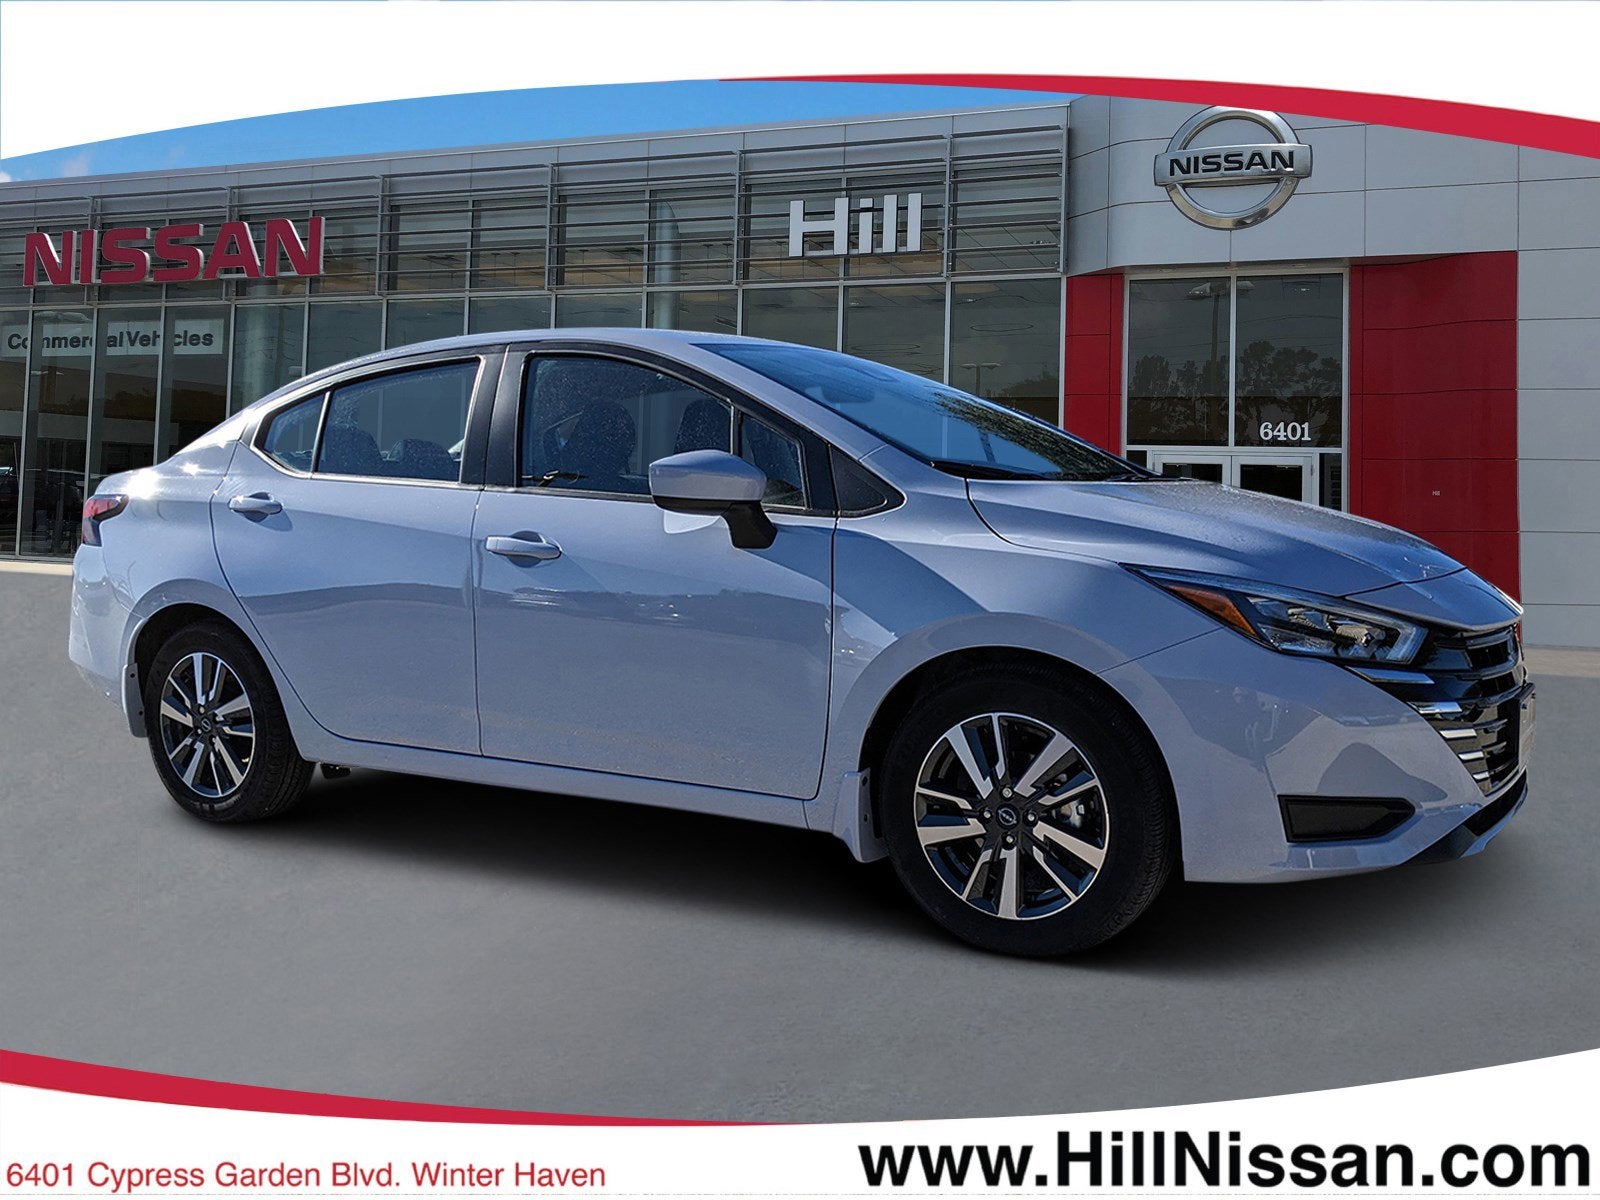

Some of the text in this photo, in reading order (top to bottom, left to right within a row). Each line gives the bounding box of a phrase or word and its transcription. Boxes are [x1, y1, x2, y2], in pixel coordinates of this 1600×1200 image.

[1169, 150, 1295, 177] NISSAN
[788, 192, 923, 257] Hill
[23, 216, 325, 287] NISSAN
[126, 330, 214, 348] Vehcles
[1259, 421, 1312, 441] 6401
